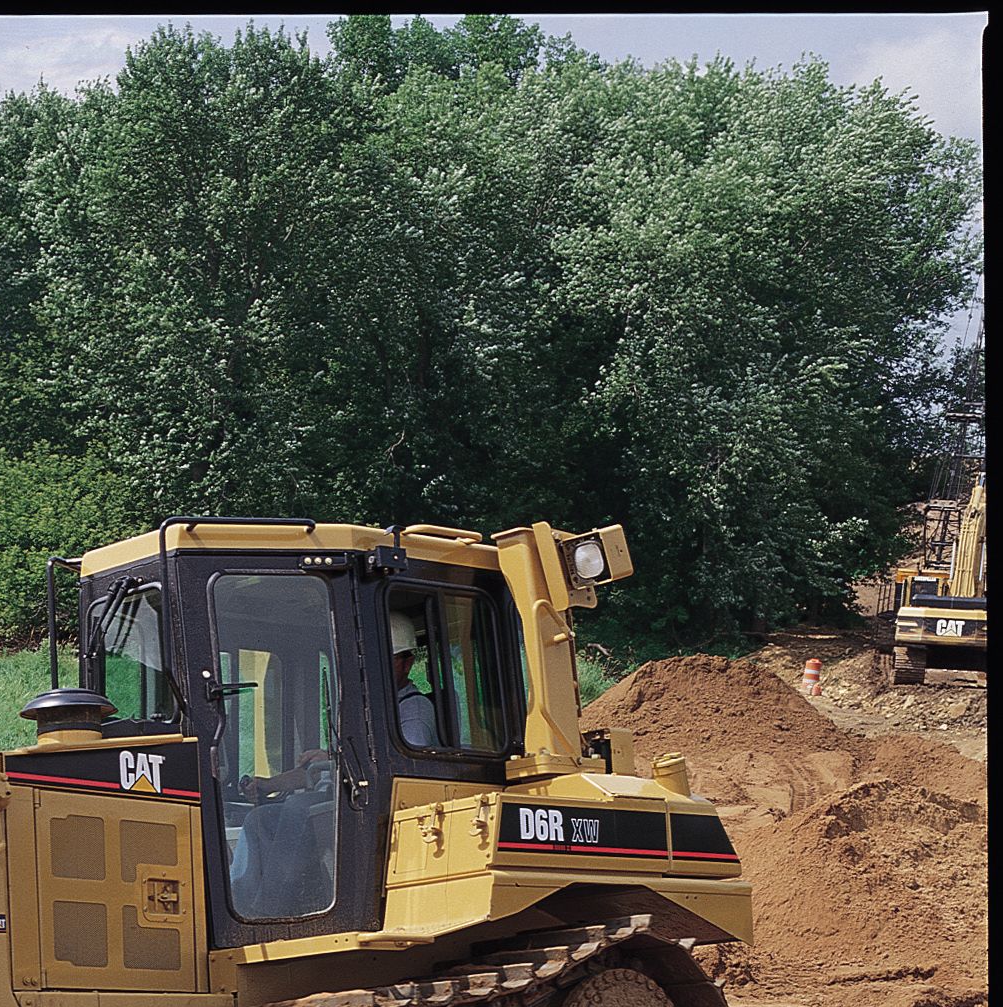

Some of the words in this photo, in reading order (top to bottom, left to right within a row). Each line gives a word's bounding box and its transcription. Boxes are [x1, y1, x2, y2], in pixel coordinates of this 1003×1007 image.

[936, 619, 966, 637] CAT
[119, 750, 165, 793] CAT
[519, 808, 564, 841] D6R
[571, 818, 599, 844] XW
